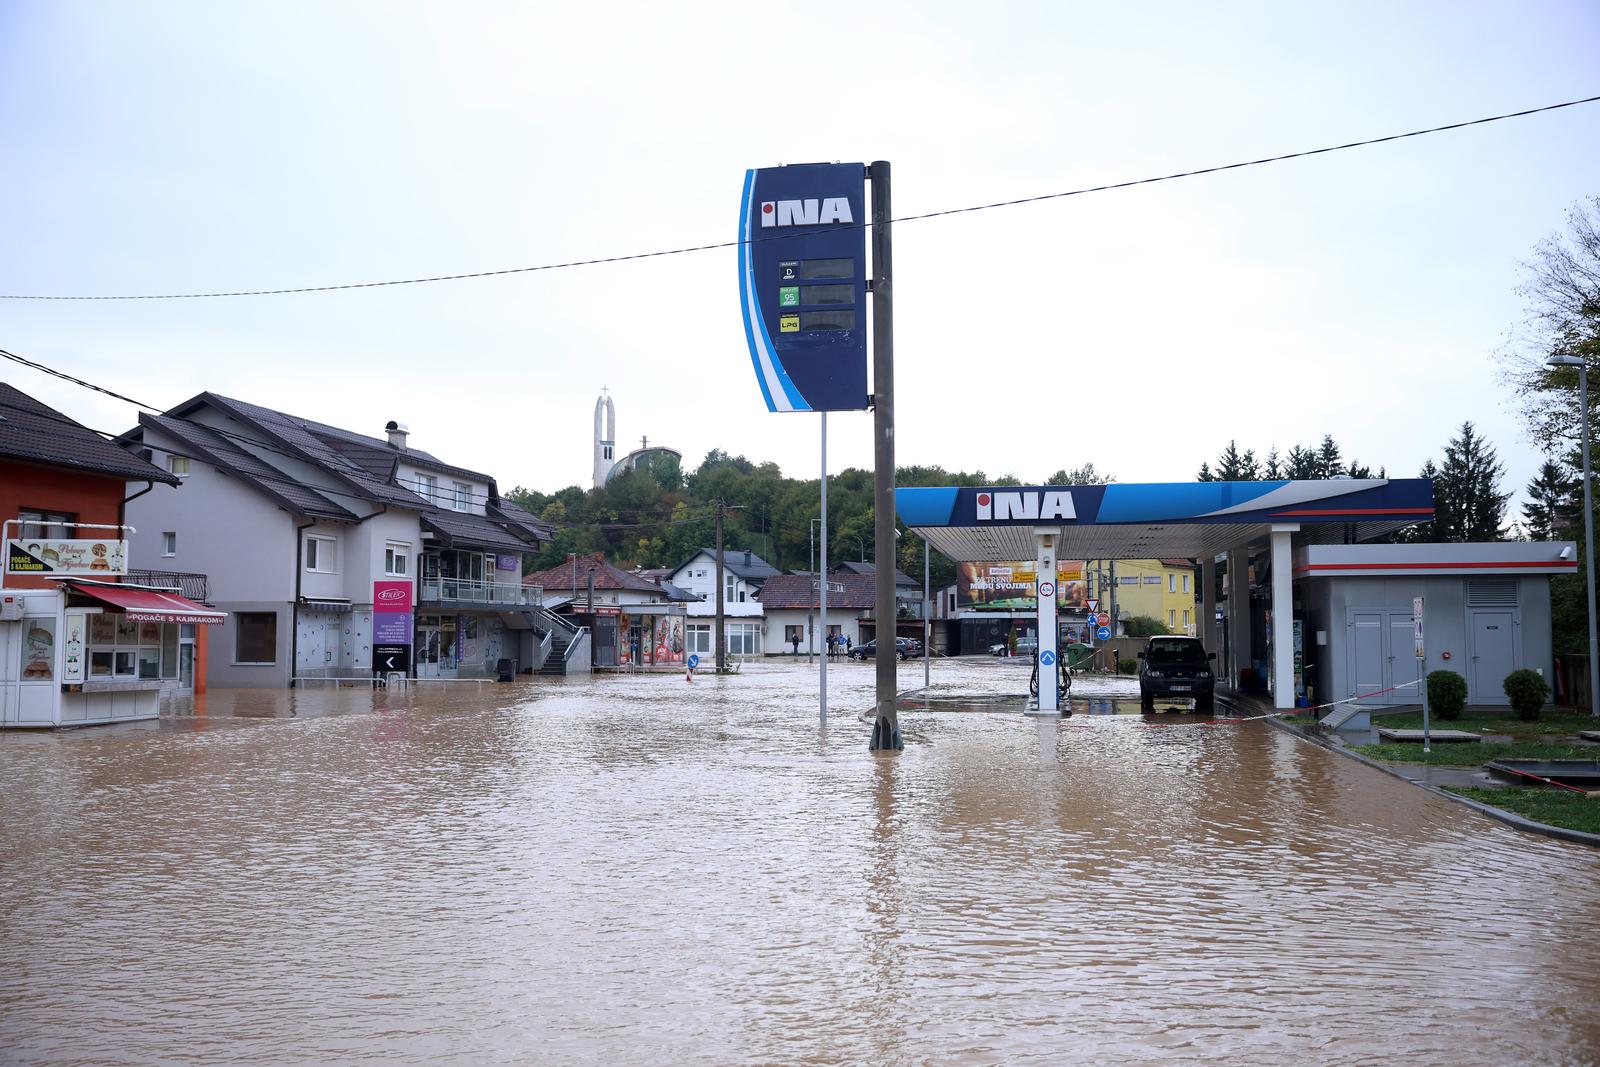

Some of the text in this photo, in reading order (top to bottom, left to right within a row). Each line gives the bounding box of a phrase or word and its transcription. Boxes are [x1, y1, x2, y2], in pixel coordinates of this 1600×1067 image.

[784, 293, 795, 301] 95
[132, 613, 166, 622] POGAČE
[176, 616, 219, 624] KAJMAKOM
